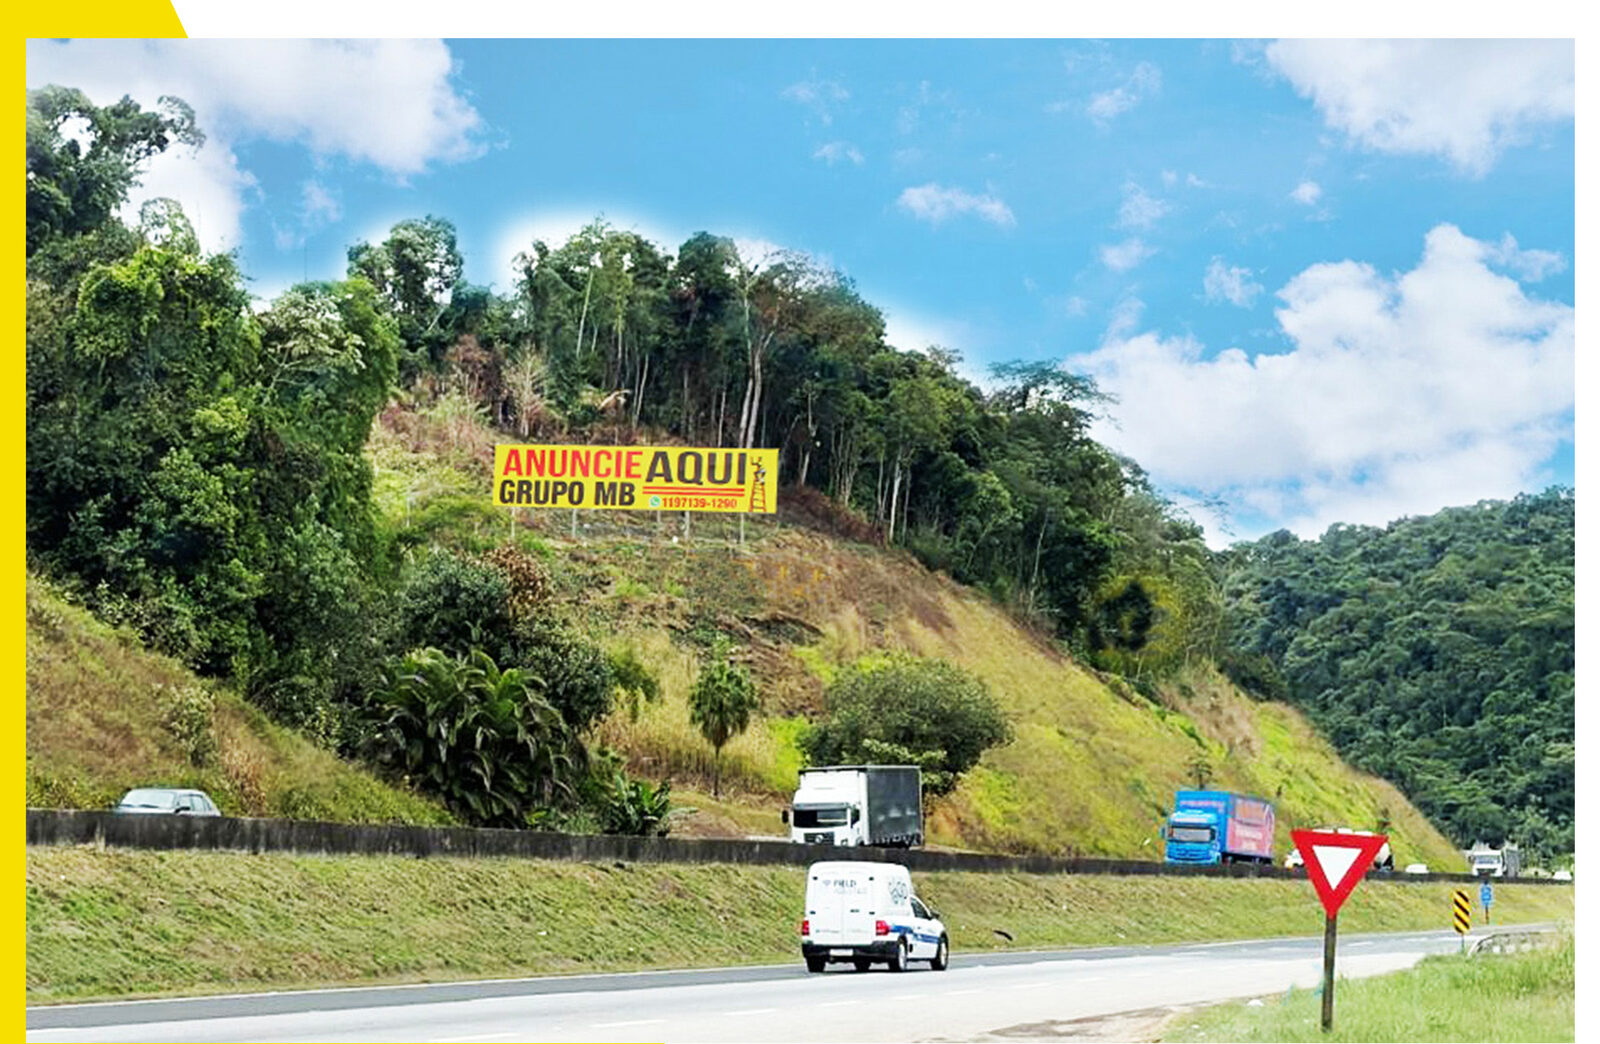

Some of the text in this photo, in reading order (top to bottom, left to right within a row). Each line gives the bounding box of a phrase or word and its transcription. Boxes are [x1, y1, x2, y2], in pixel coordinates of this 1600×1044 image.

[503, 449, 747, 486] ANUNCIE AQUI
[499, 479, 635, 507] GRUPO MB
[662, 497, 738, 509] 1197139-1290
